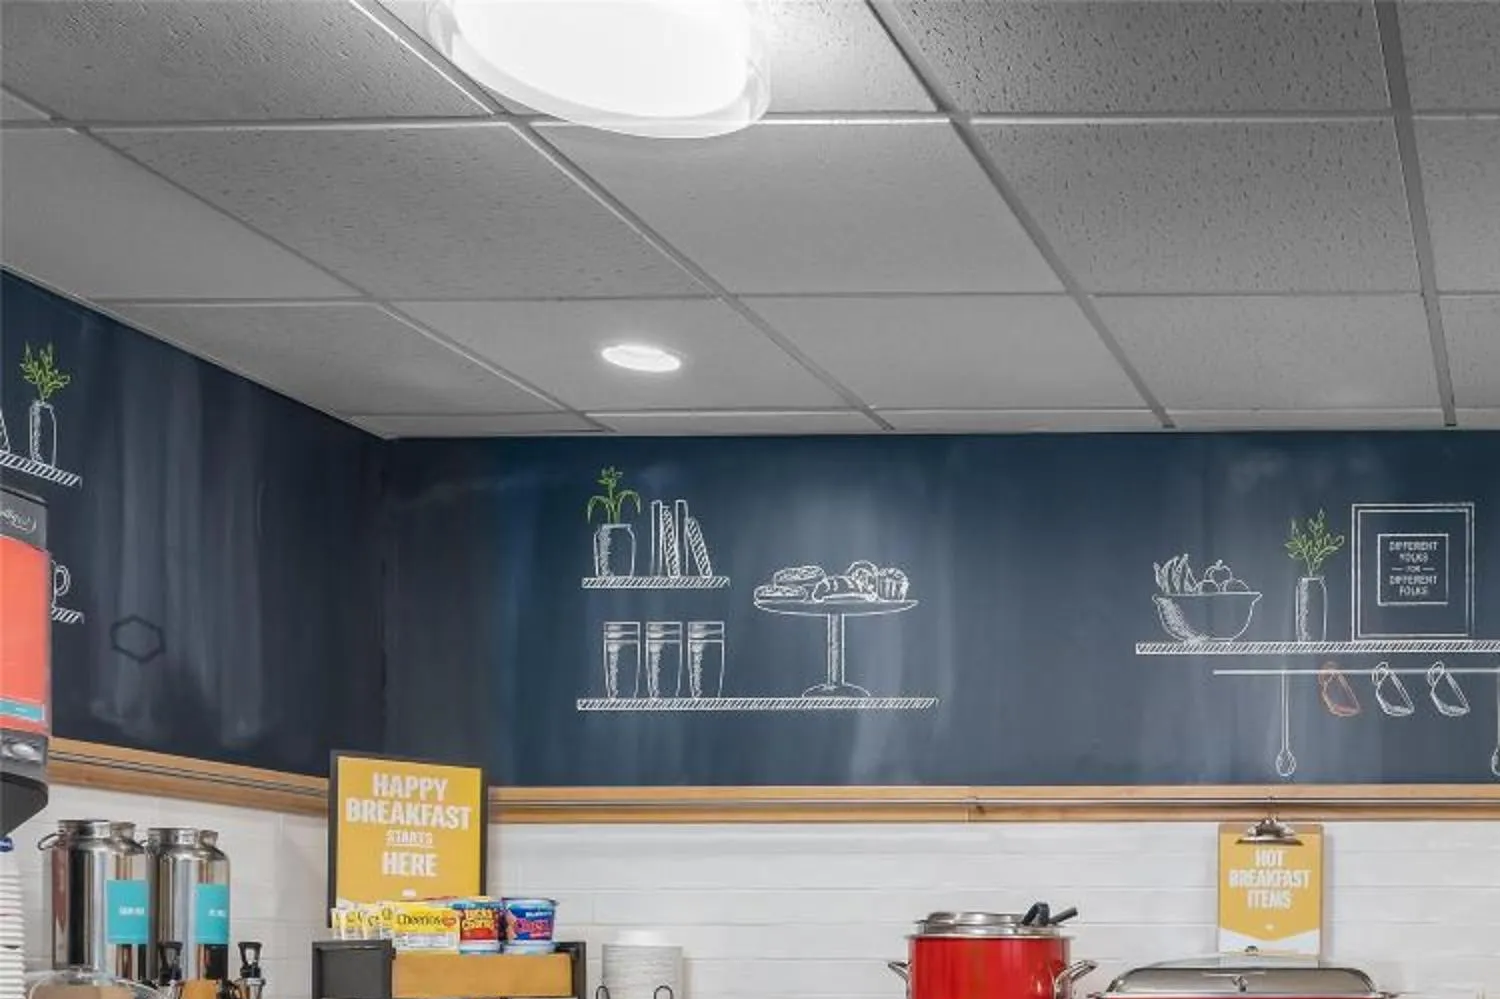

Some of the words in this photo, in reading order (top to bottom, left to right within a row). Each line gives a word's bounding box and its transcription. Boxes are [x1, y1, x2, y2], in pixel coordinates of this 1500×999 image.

[372, 771, 449, 802] HAPPY
[344, 797, 472, 831] BREAKFAST
[381, 850, 439, 878] HERE
[1253, 849, 1286, 868] HOT
[1228, 868, 1313, 890] BREAKFAST
[1246, 888, 1293, 910] ITEMS
[396, 912, 443, 927] Cheerios
